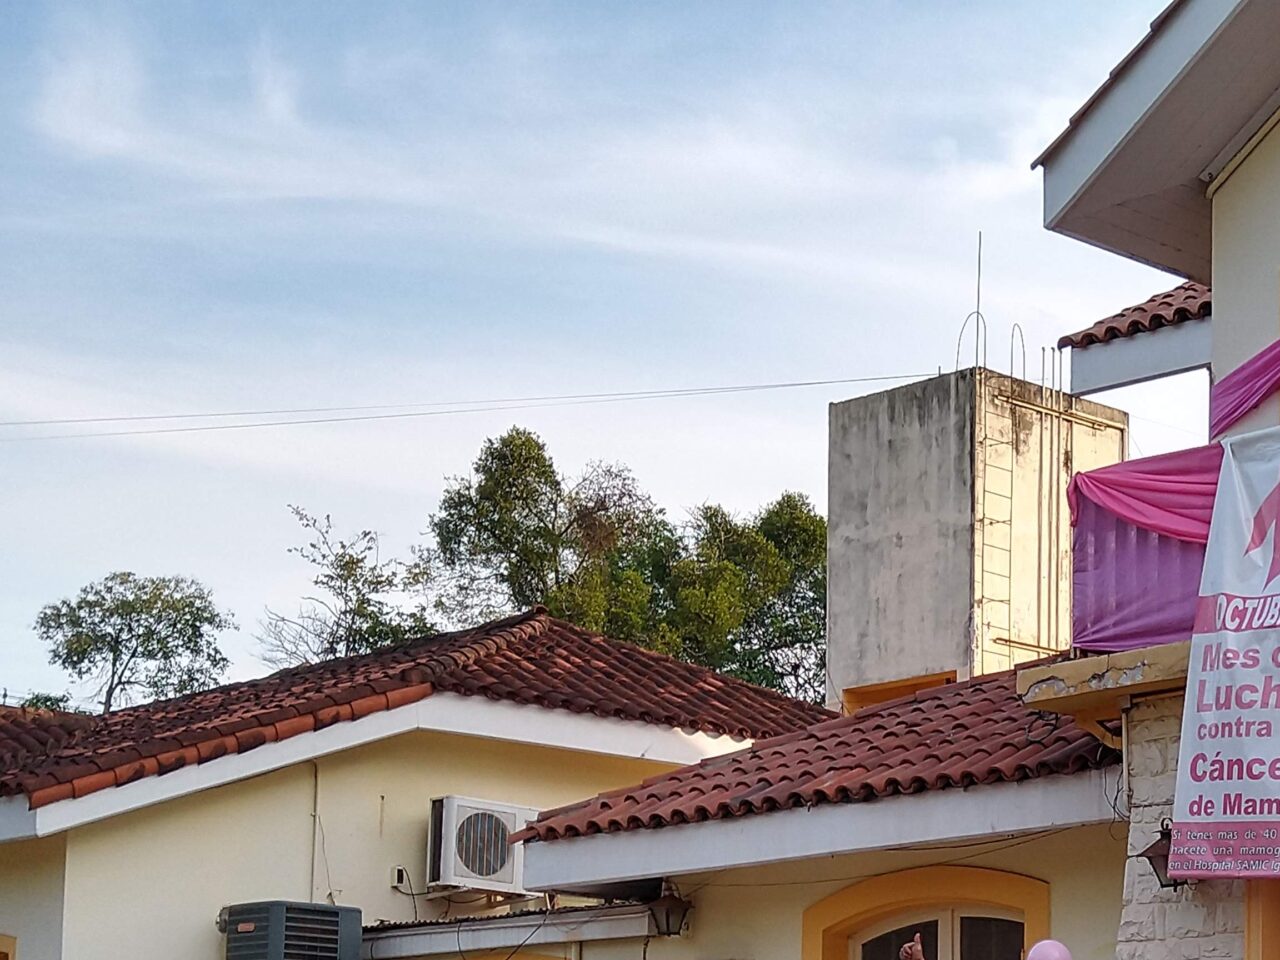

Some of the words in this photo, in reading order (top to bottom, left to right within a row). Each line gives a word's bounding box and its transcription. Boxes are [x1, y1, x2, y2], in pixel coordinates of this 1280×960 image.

[1201, 642, 1260, 672] Mes
[1197, 715, 1273, 741] contra
[1188, 794, 1215, 817] de
[1187, 830, 1213, 840] tenes
[1244, 829, 1257, 840] de
[1263, 828, 1278, 840] 40
[1170, 844, 1207, 855] hacete
[1213, 845, 1233, 855] una
[1168, 861, 1181, 870] en
[1183, 860, 1192, 870] el
[1194, 860, 1234, 873] Hospital
[1236, 860, 1269, 871] SAMIC
